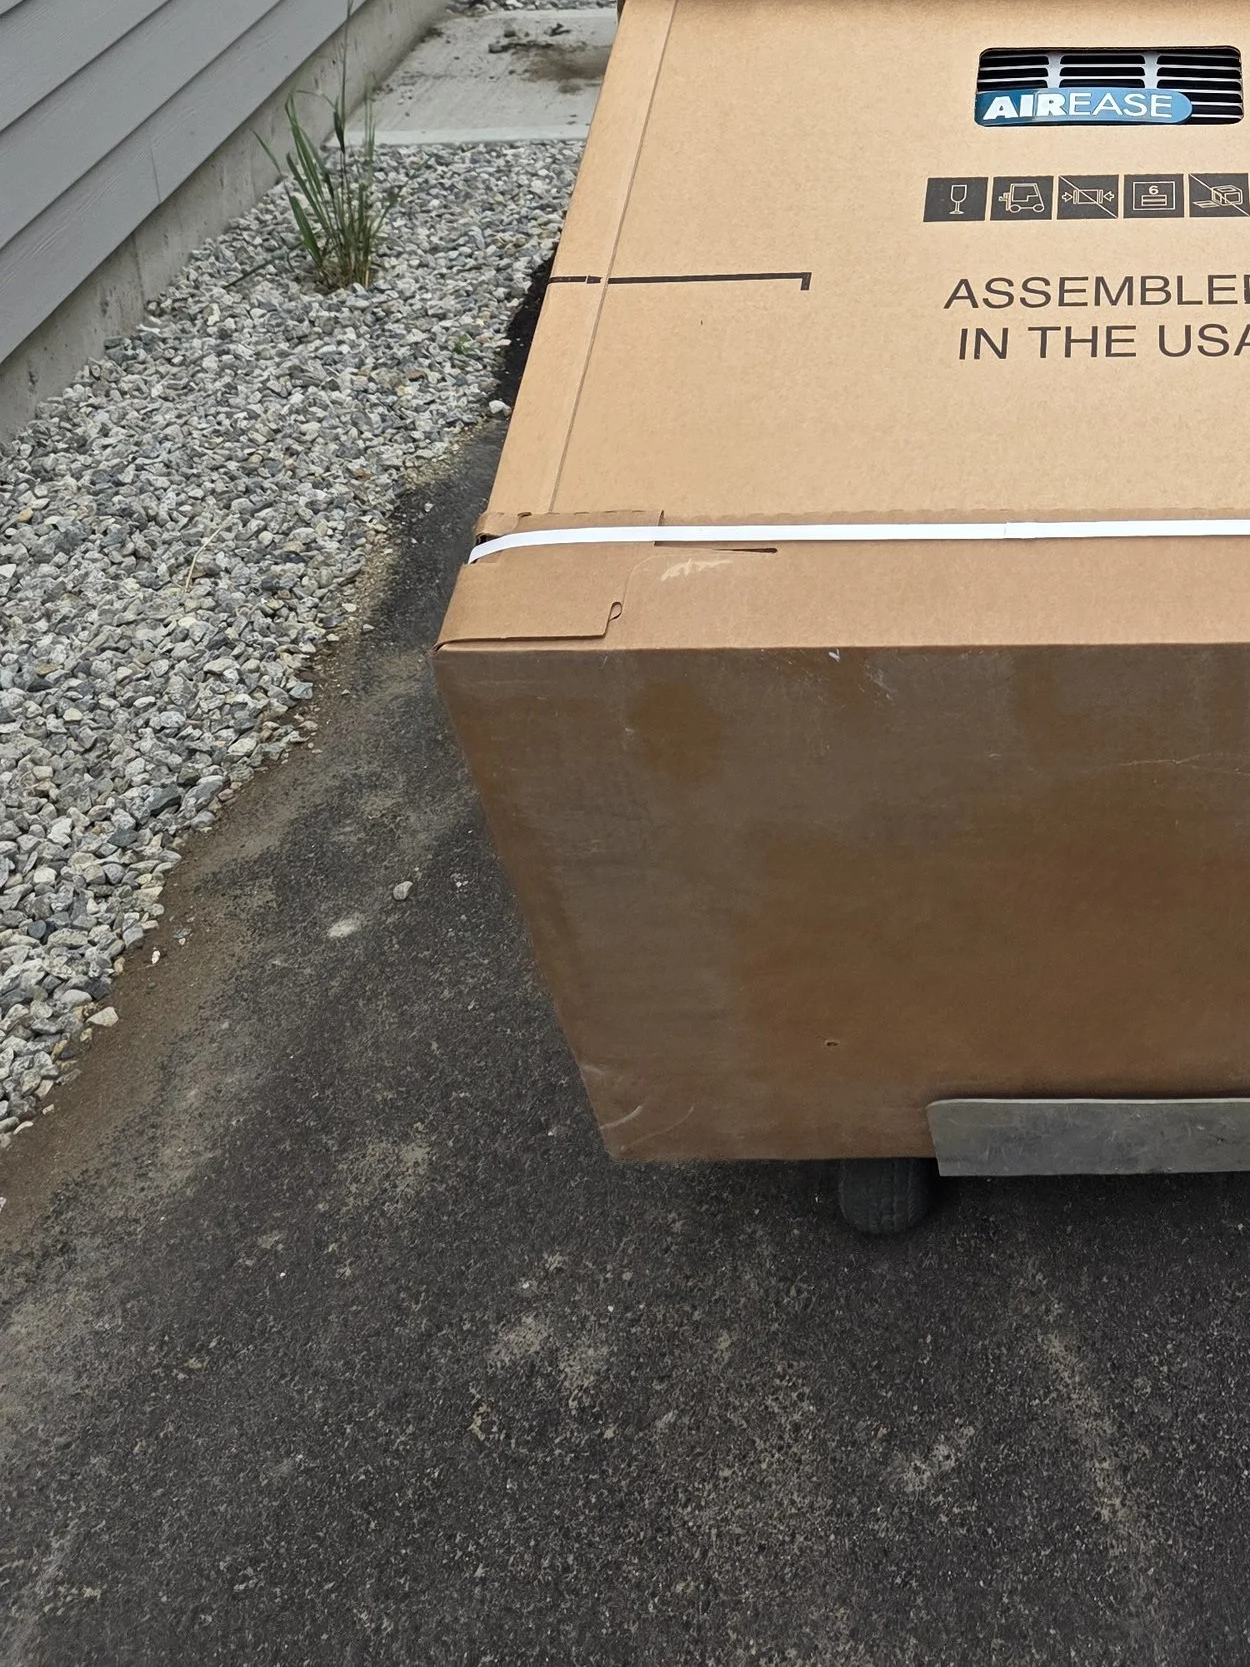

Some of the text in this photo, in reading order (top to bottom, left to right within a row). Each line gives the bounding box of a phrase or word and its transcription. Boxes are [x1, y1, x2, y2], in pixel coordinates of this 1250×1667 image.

[982, 92, 1173, 121] AIREASE
[958, 327, 1009, 361] IN
[1027, 324, 1137, 359] THE
